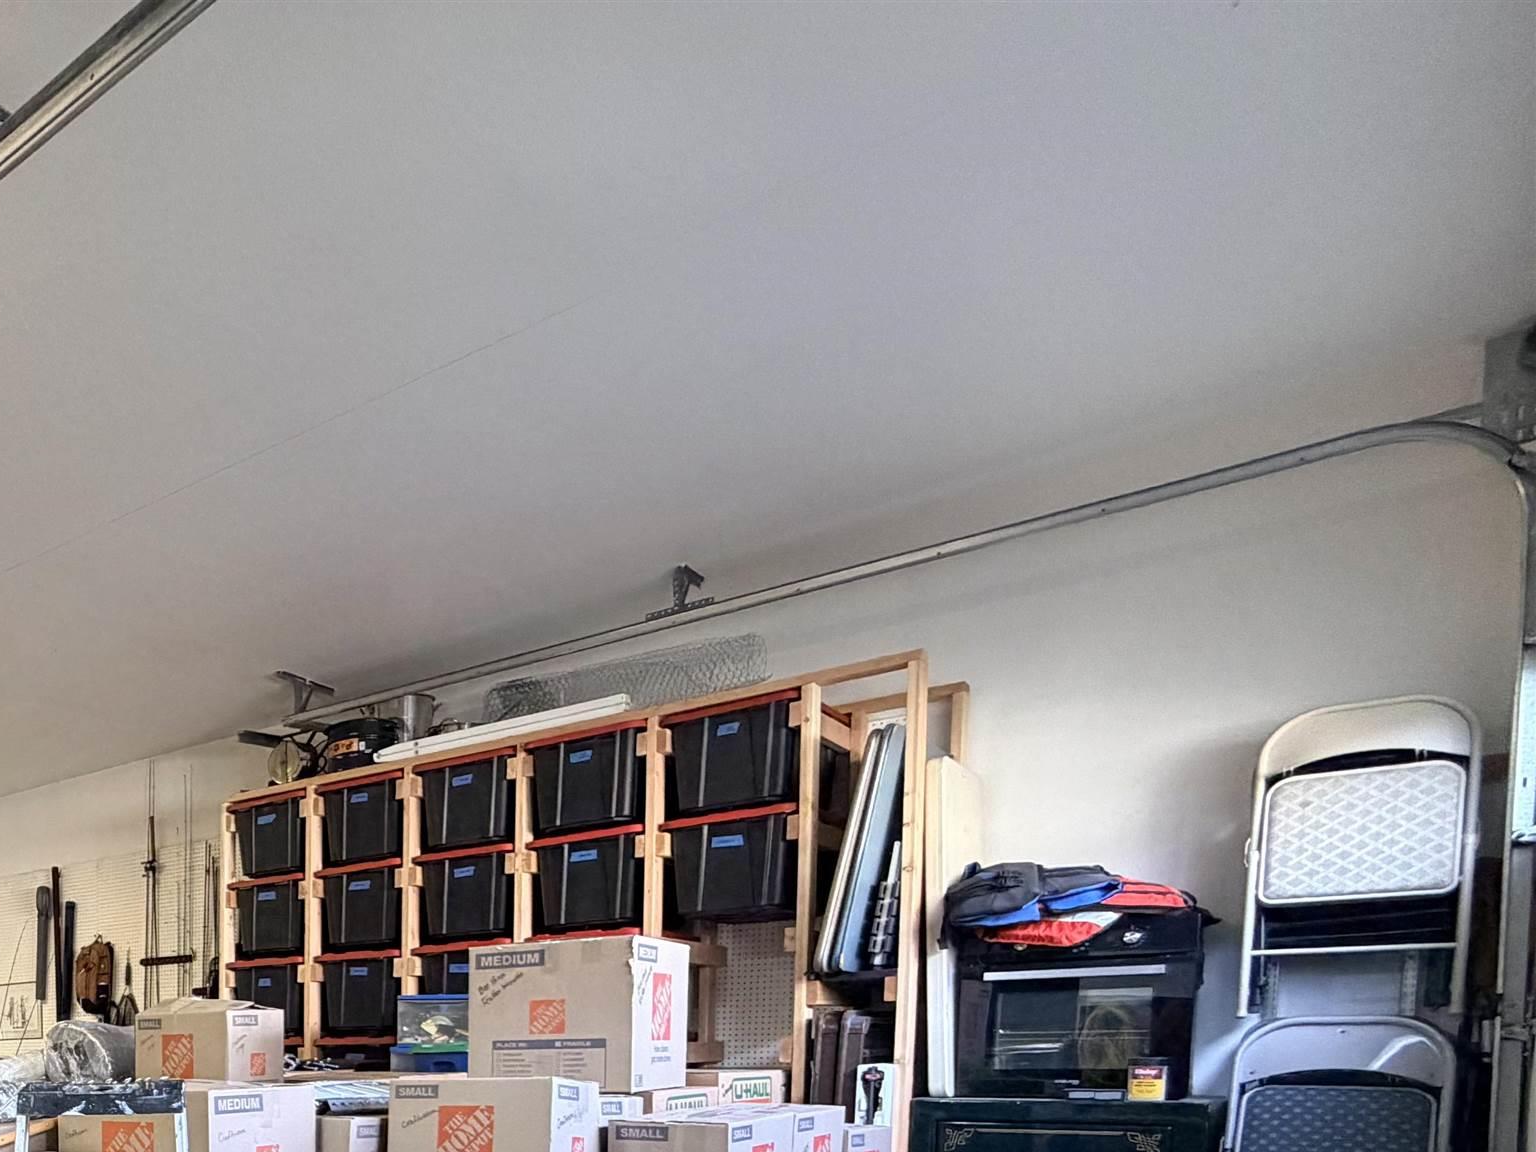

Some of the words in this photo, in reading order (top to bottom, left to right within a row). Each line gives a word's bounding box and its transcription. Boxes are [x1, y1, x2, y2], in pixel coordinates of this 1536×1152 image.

[480, 952, 539, 966] MEDIUM
[235, 1016, 256, 1025] SMALL
[399, 1087, 434, 1096] SMALL
[735, 1082, 769, 1099] U-HAUL
[218, 1097, 260, 1112] MEDIUM
[620, 1128, 664, 1138] SMALL
